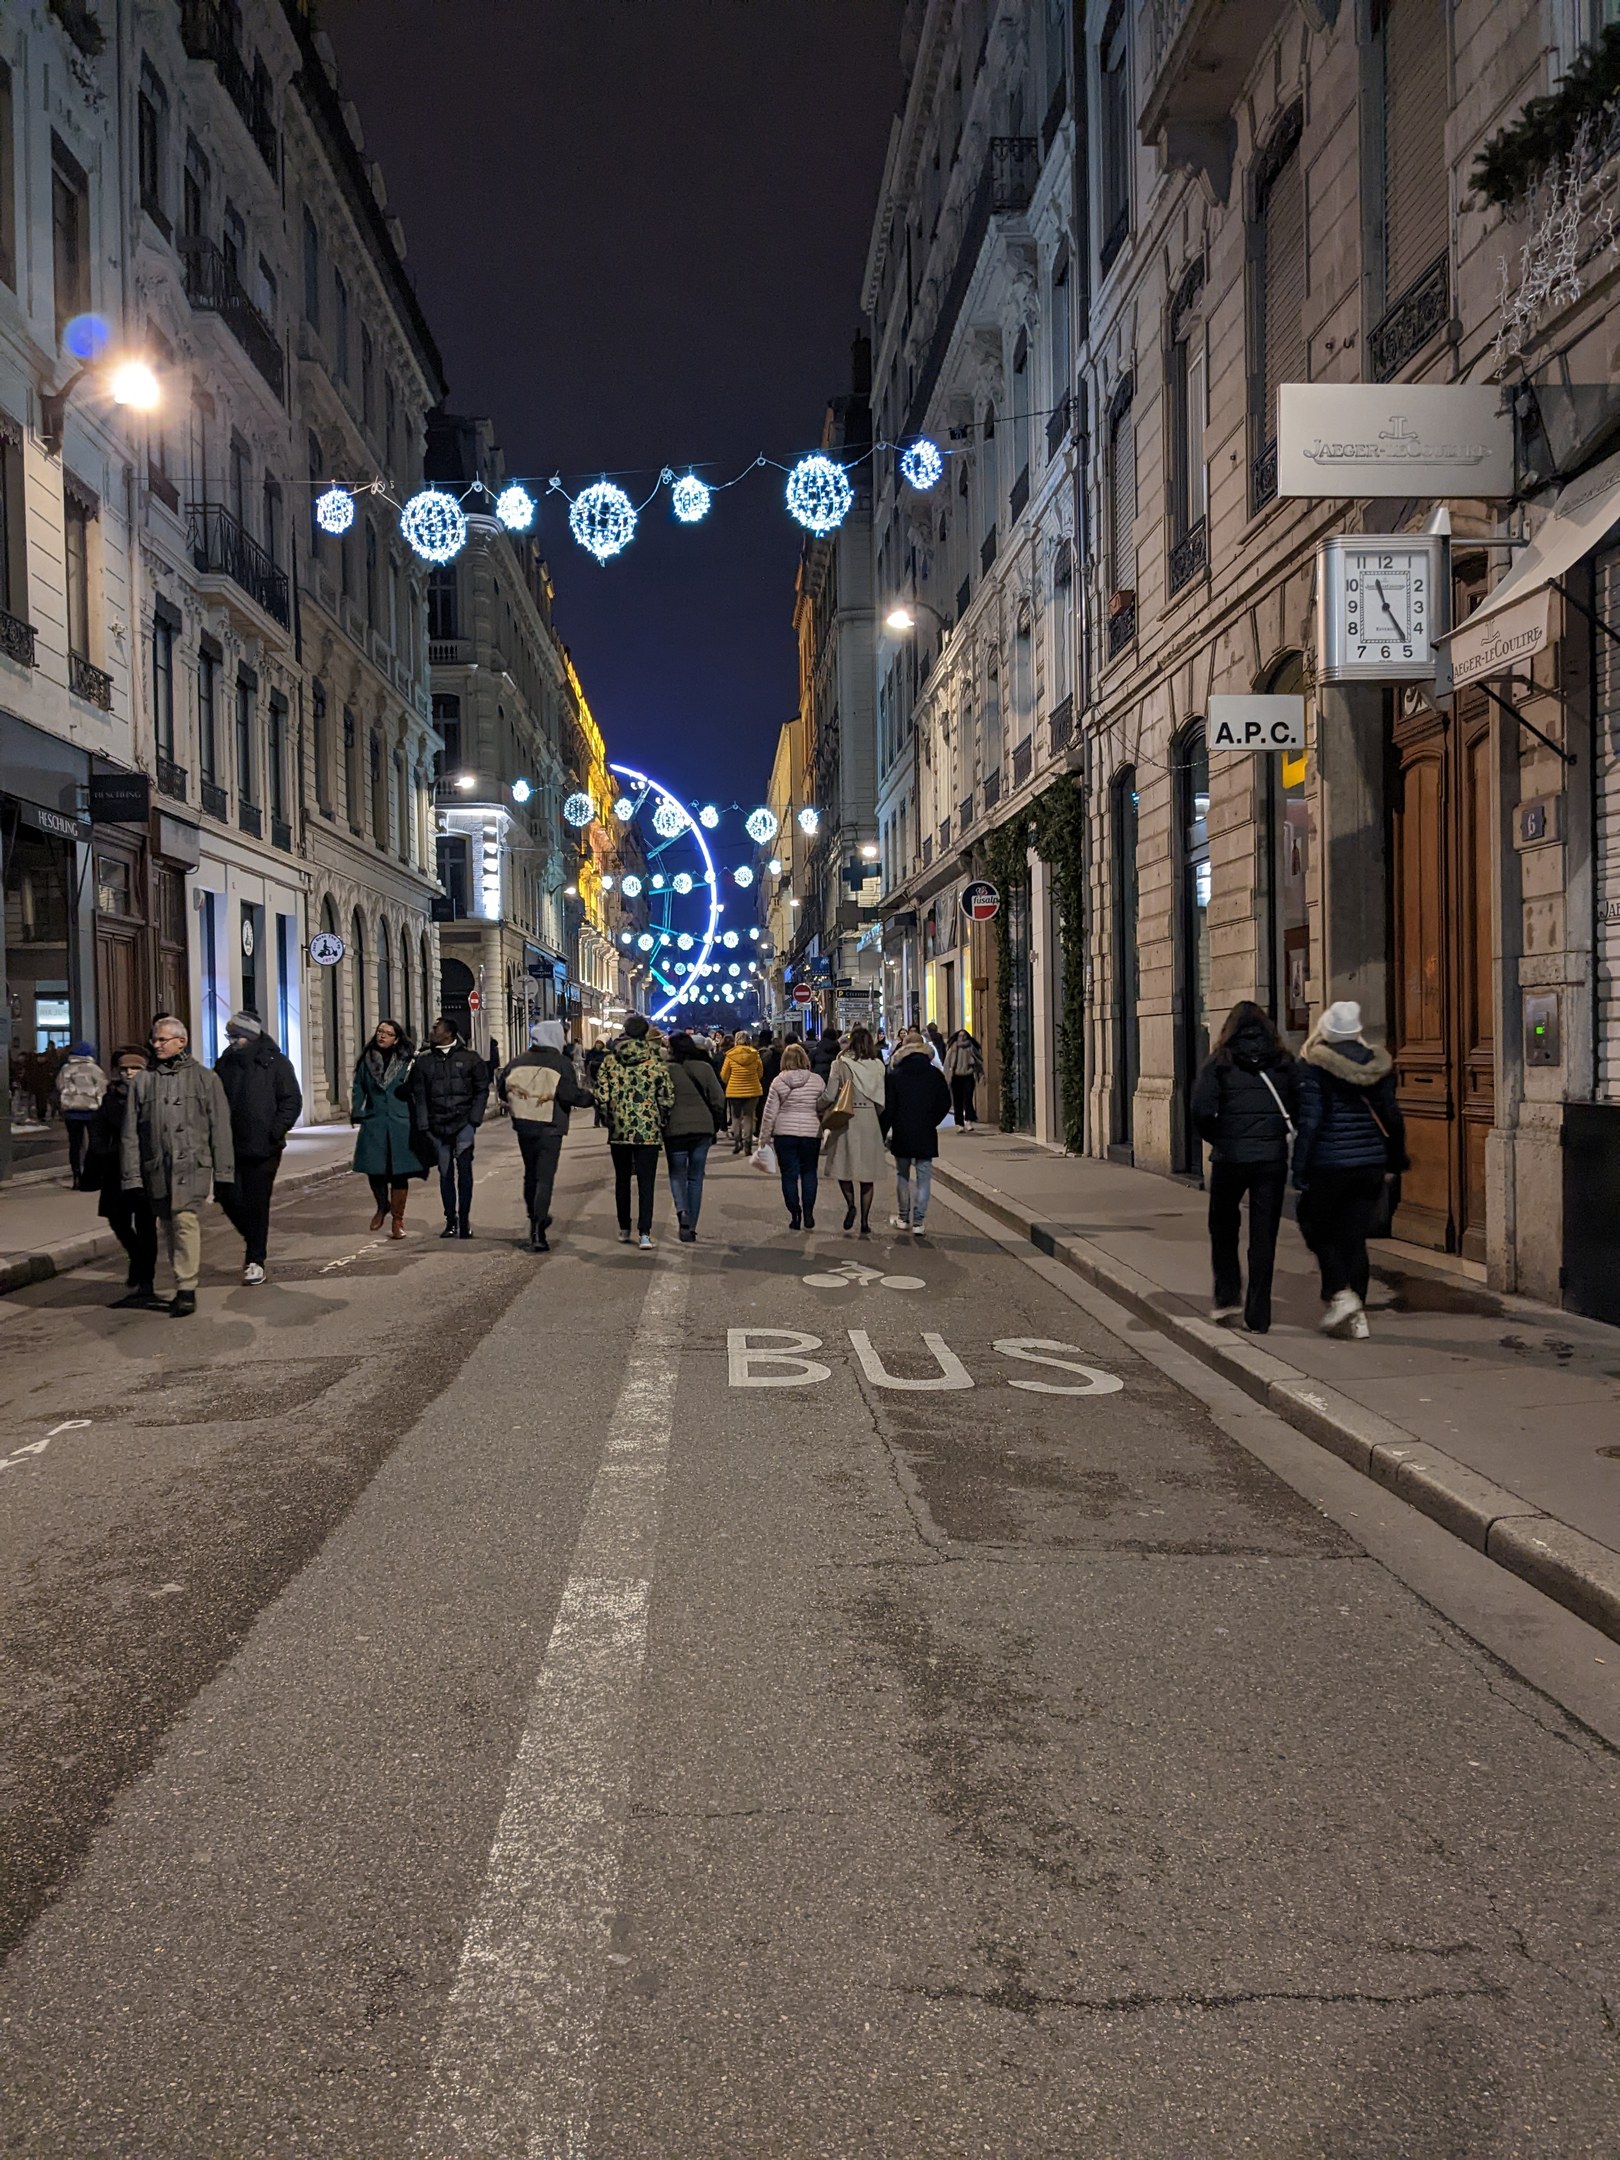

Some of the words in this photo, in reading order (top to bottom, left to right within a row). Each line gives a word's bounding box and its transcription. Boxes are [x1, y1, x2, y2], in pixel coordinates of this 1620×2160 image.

[1357, 556, 1366, 569] 11
[1379, 556, 1393, 569] 12
[1408, 556, 1412, 569] 1
[1346, 579, 1359, 592] 10
[1414, 579, 1424, 592] 2
[1348, 601, 1358, 613] 9
[1414, 601, 1424, 614] 3
[1348, 622, 1358, 635] 8
[1413, 622, 1424, 635] 4
[1357, 646, 1367, 658] 7
[1381, 646, 1391, 658] 6
[1403, 645, 1413, 658] 5
[1215, 721, 1297, 744] A.P.C.
[38, 810, 78, 836] HESCHUNG
[1527, 813, 1536, 837] 6
[973, 896, 1000, 905] fusalp
[727, 1328, 1124, 1396] BUS
